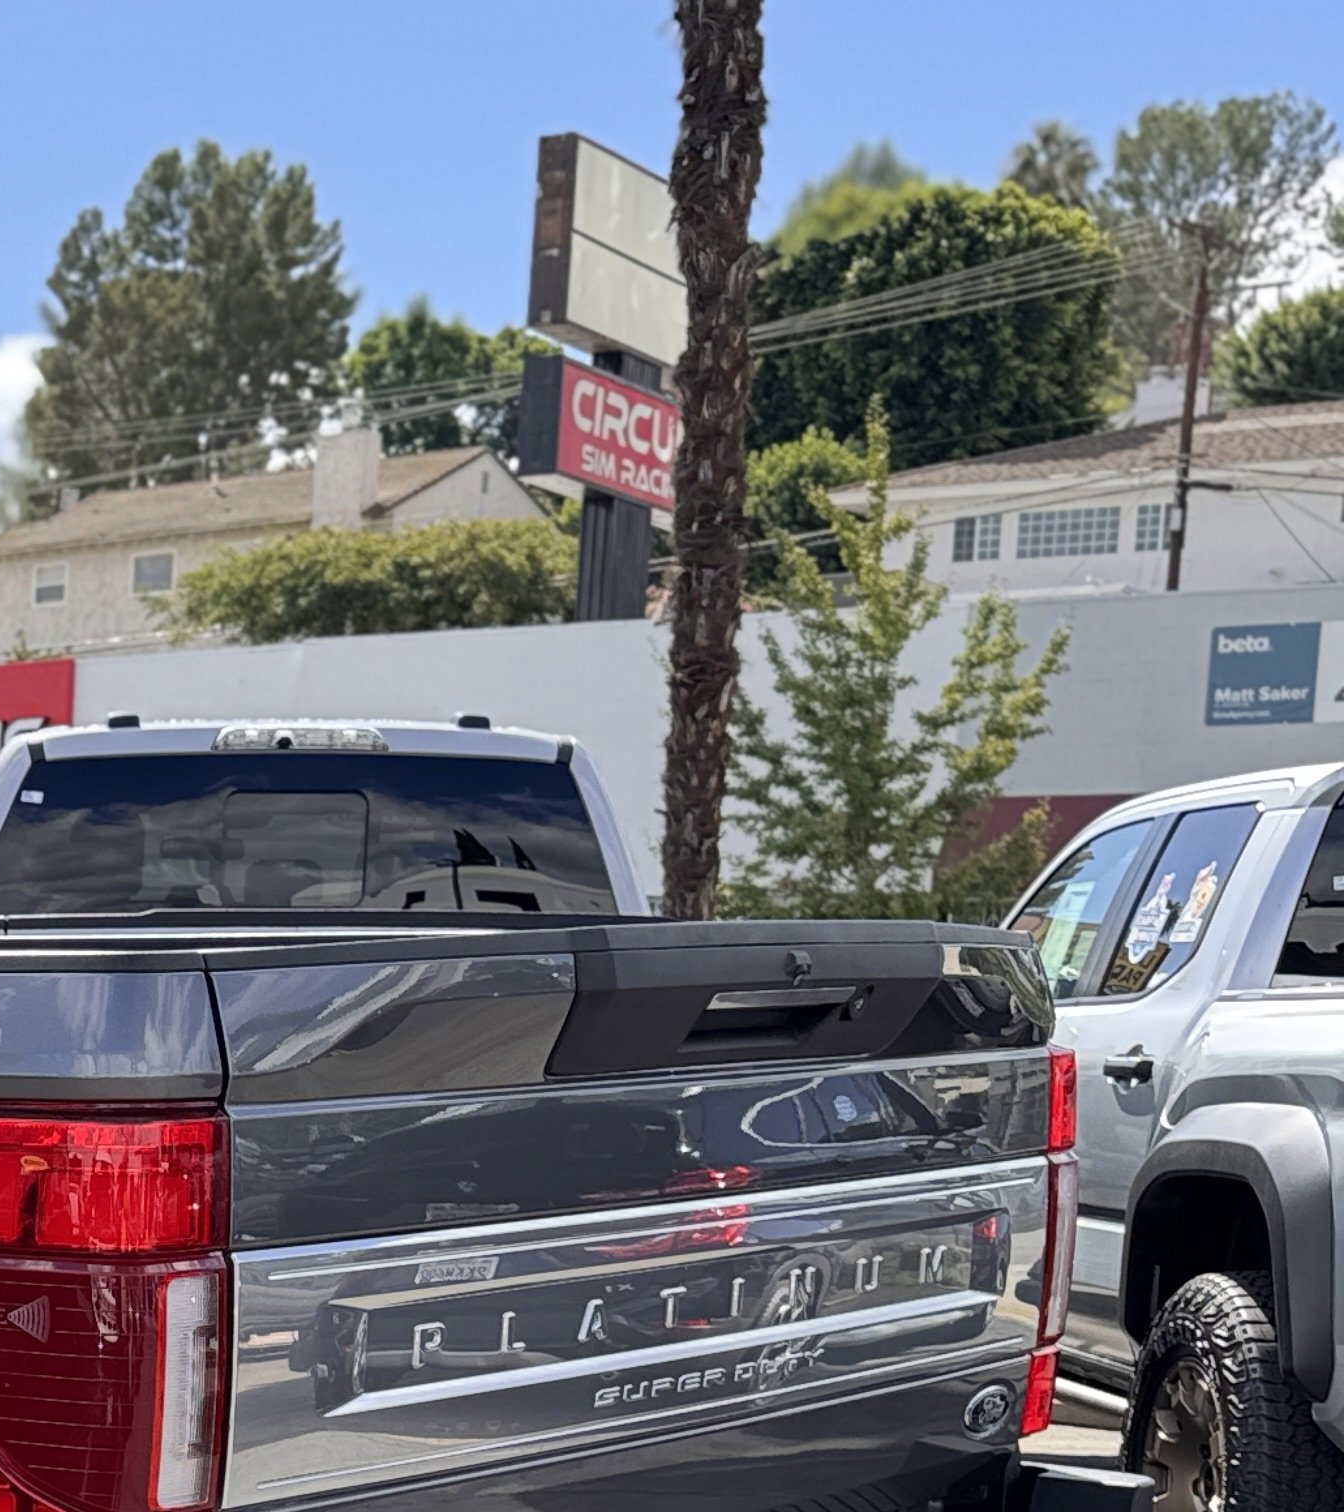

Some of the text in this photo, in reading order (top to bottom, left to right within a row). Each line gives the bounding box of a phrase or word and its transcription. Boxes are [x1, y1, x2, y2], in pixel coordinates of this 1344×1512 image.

[581, 443, 676, 501] SIM RACIN
[1213, 685, 1310, 704] Matt Saker
[411, 1245, 949, 1370] PLATINUM
[594, 1347, 825, 1408] SUPER DUTY
